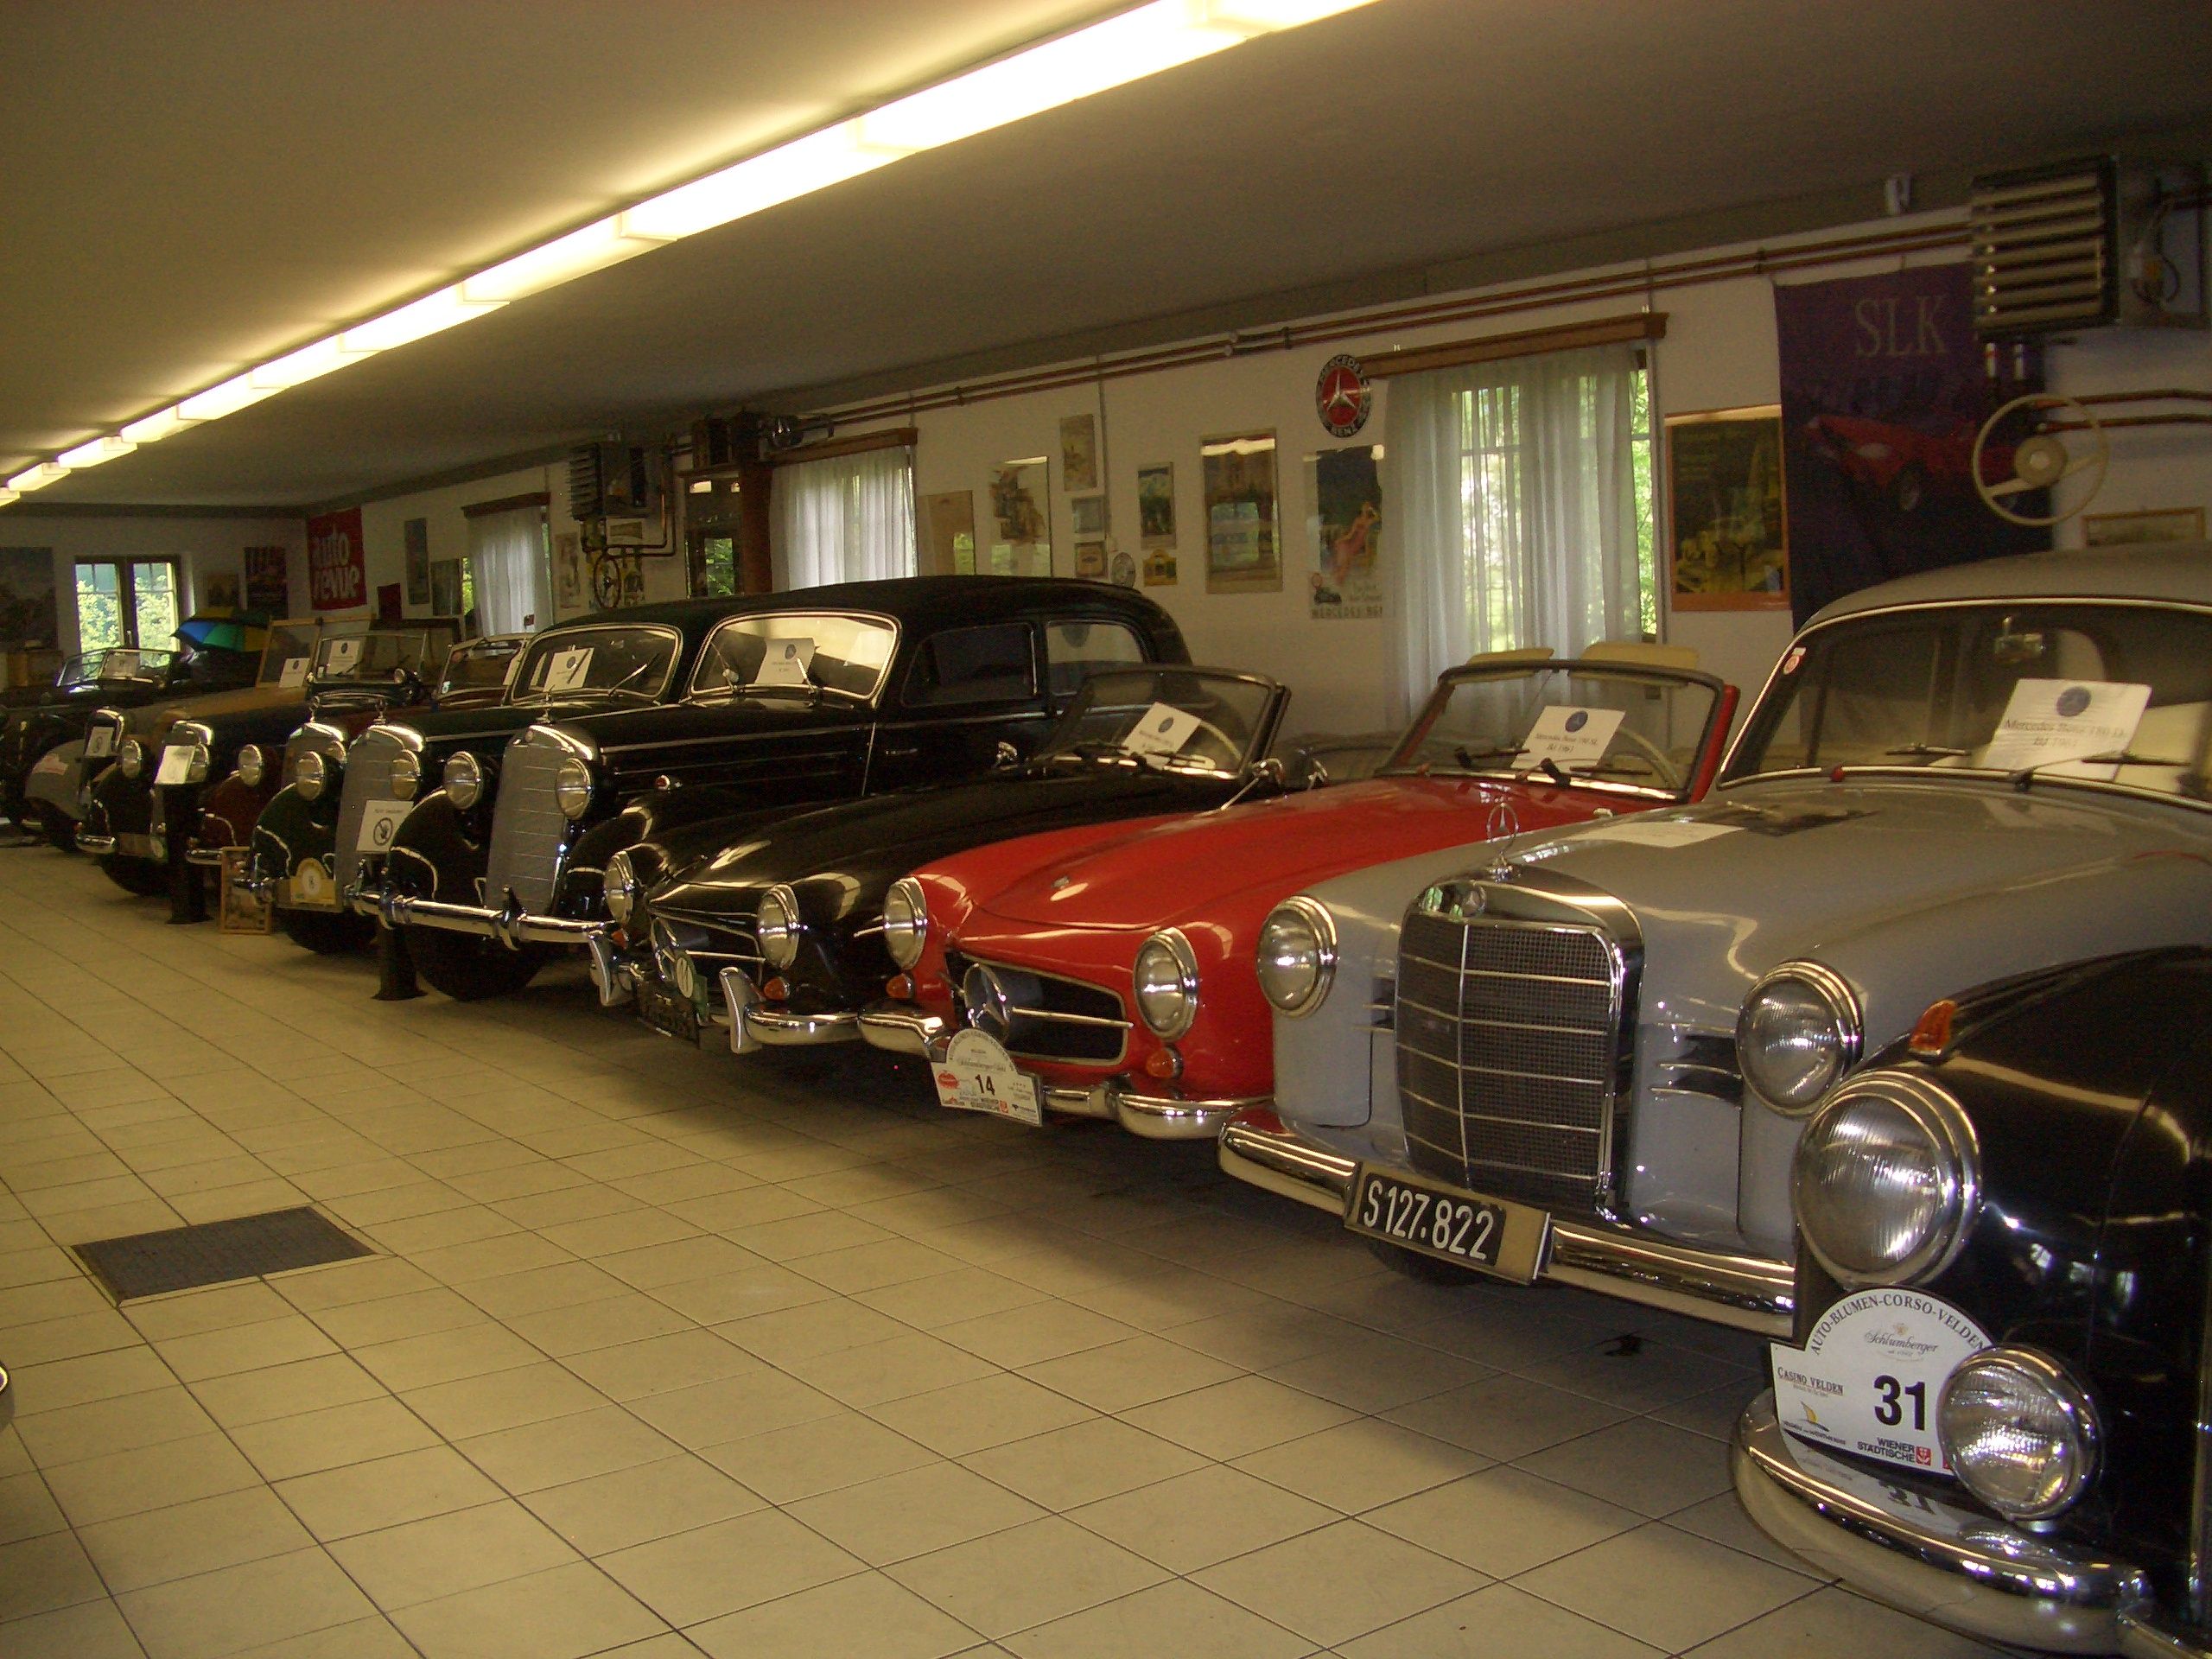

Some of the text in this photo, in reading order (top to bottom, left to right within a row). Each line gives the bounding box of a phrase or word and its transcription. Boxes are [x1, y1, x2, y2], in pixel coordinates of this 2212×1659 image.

[1854, 294, 1948, 359] SLK
[311, 524, 349, 568] auto
[312, 565, 359, 601] revue
[976, 1073, 995, 1096] 14
[1363, 1179, 1494, 1261] S 127.822
[1864, 1331, 1939, 1355] Schlumberger
[1810, 1376, 1844, 1395] VELDEN
[1873, 1374, 1926, 1431] 31
[1877, 1437, 1916, 1453] WIENER
